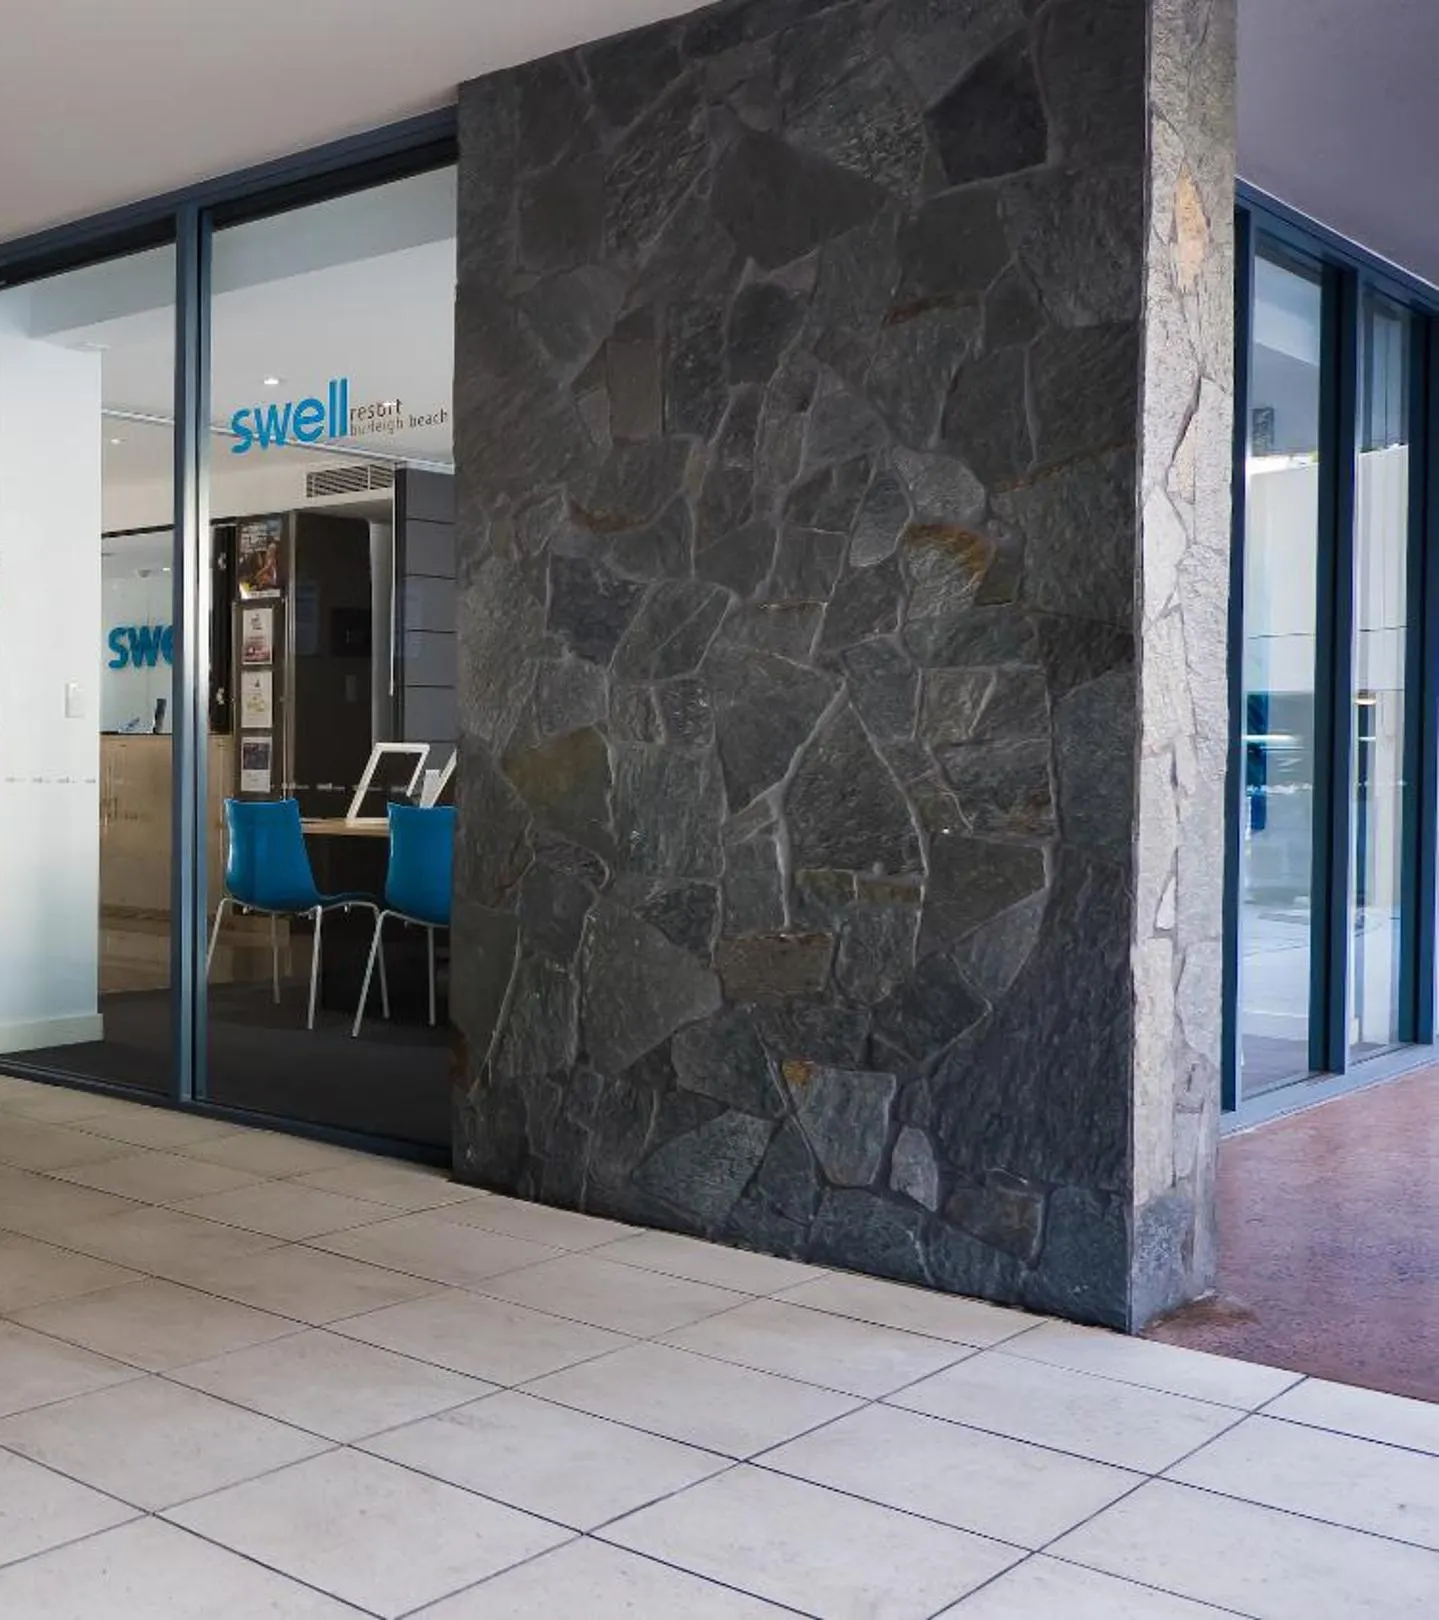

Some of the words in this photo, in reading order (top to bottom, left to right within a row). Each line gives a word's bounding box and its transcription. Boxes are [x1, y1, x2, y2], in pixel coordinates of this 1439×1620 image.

[231, 377, 348, 453] swell
[349, 398, 402, 421] resort
[408, 408, 448, 428] beach
